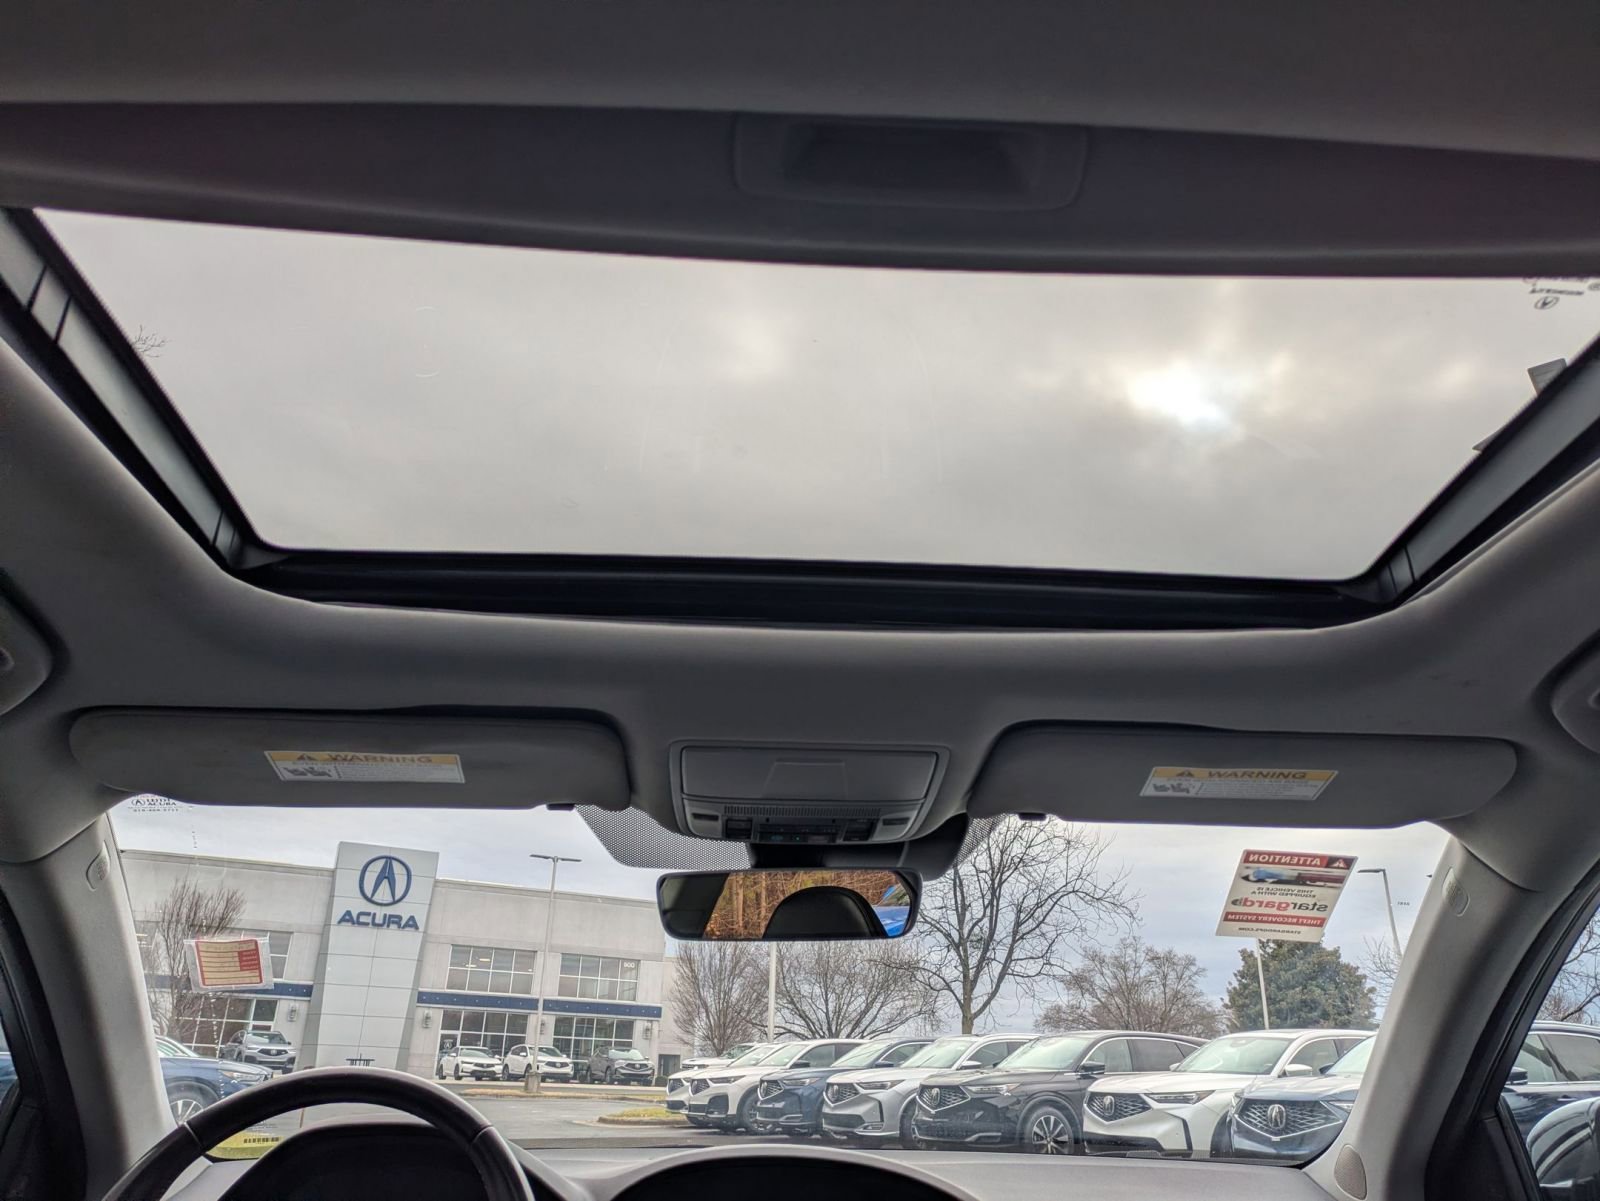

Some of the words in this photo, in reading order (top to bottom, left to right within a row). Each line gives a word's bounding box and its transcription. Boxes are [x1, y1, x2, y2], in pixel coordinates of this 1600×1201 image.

[328, 753, 433, 764] WARNING
[1207, 770, 1307, 780] WARNING
[337, 910, 419, 930] ACURA
